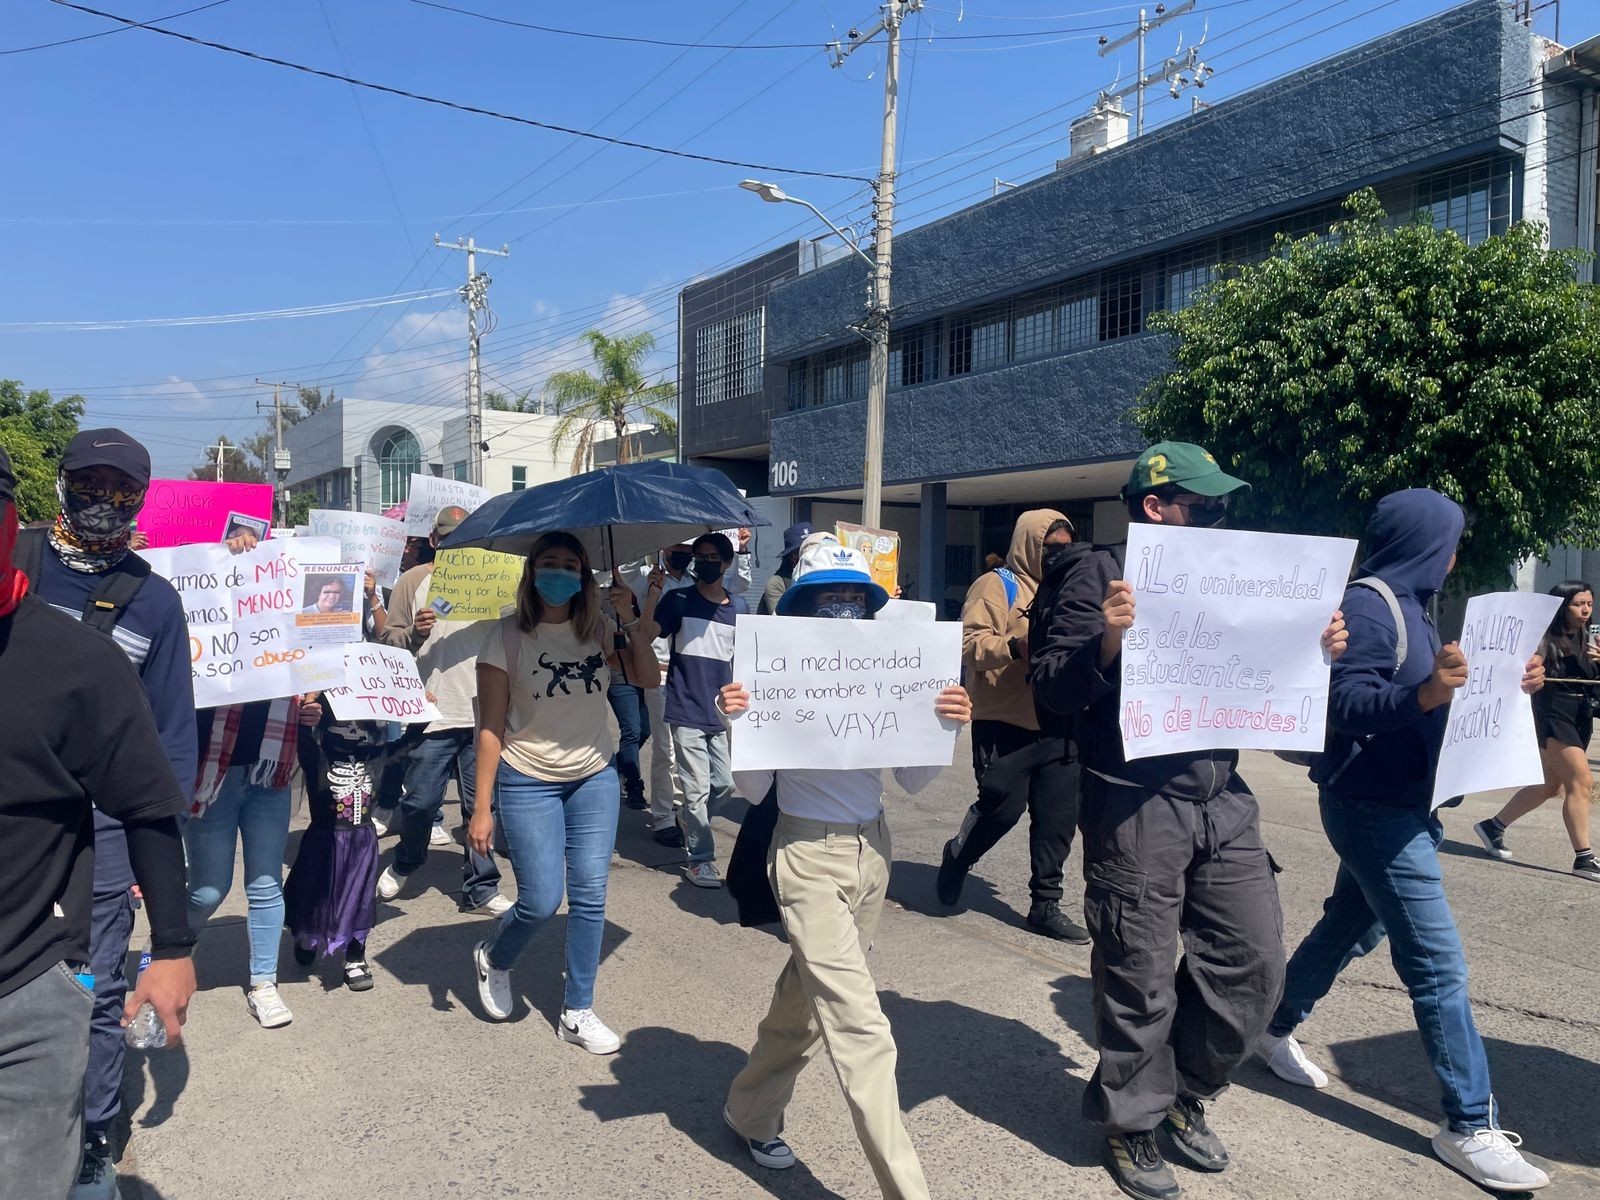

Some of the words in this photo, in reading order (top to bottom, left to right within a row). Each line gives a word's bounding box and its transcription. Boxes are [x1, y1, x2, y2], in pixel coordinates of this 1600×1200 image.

[771, 460, 798, 487] 106
[1148, 454, 1170, 486] 2
[225, 565, 246, 588] de
[255, 552, 298, 583] MÁS
[303, 564, 360, 574] RENUNCIA
[482, 554, 500, 569] por
[1135, 544, 1189, 595] ¡La
[1199, 564, 1327, 601] universidad
[237, 588, 294, 618] MENOS
[429, 582, 460, 596] Estan
[476, 587, 491, 596] por
[212, 631, 239, 657] NO
[249, 627, 281, 646] son
[1126, 627, 1150, 651] es
[1155, 610, 1188, 650] de
[1188, 611, 1223, 651] los
[206, 659, 244, 678] son
[253, 648, 306, 668] abuso
[358, 653, 378, 667] mi
[754, 631, 787, 674] La
[801, 646, 922, 672] mediocridad
[360, 676, 386, 691] LOS
[390, 675, 424, 691] HIJOS
[1124, 649, 1276, 694] estudiantes,
[751, 679, 797, 701] tiene
[804, 681, 866, 700] nombre
[747, 709, 781, 731] que
[794, 708, 816, 723] se
[825, 710, 900, 740] VAYA
[1123, 699, 1153, 741] No
[1162, 695, 1192, 733] de
